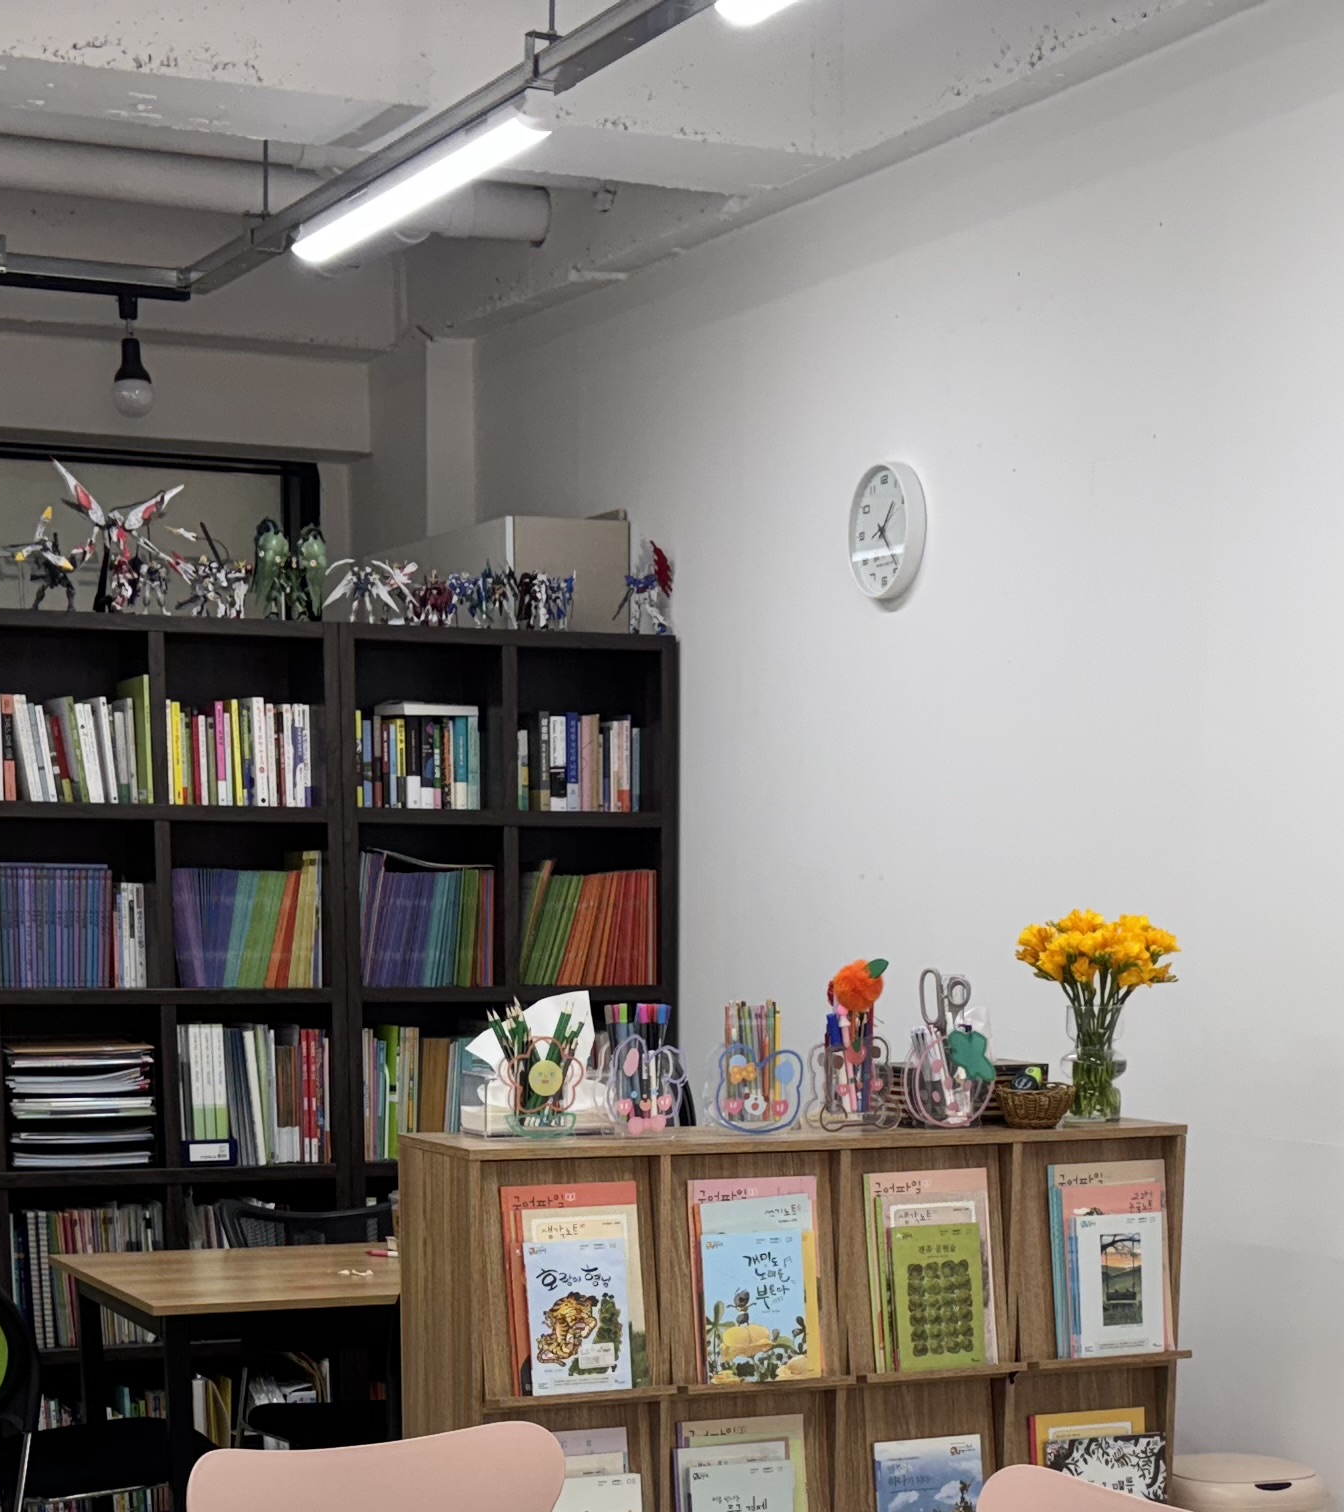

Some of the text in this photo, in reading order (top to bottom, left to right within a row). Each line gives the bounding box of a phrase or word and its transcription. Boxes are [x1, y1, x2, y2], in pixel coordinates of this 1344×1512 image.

[742, 1251, 779, 1267] 개미도
[536, 1264, 611, 1291] 호랑이 형님
[755, 1284, 790, 1310] 부른다
